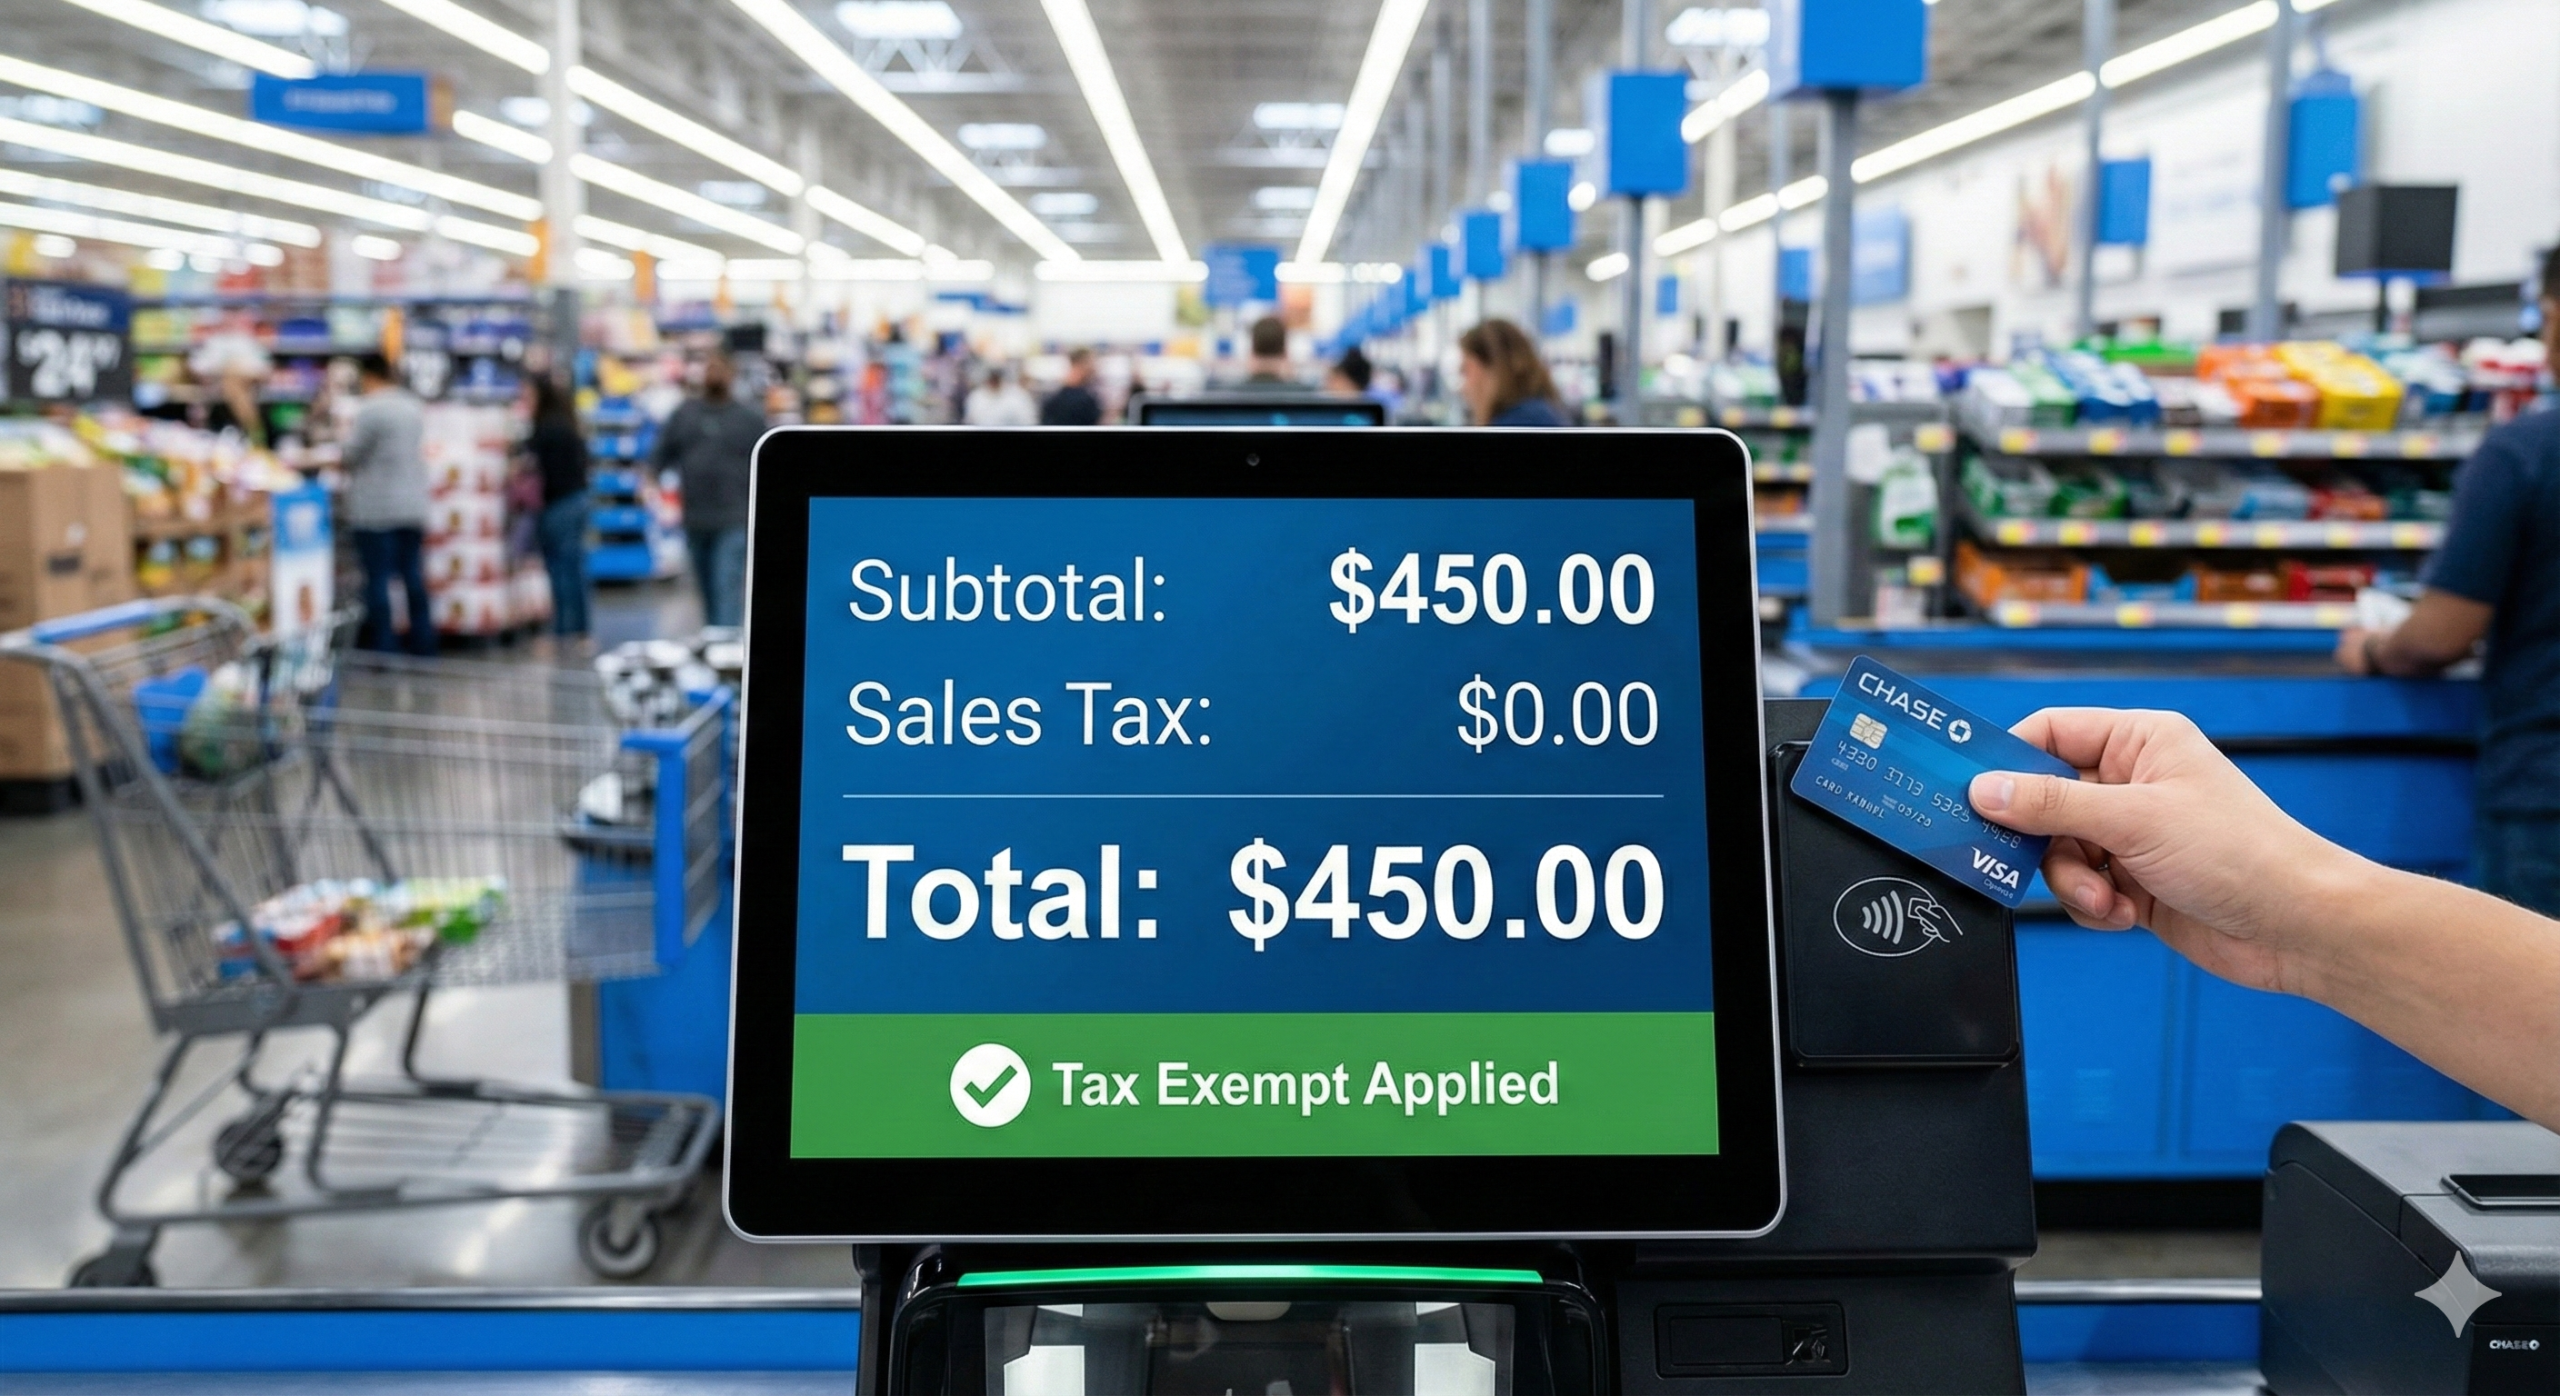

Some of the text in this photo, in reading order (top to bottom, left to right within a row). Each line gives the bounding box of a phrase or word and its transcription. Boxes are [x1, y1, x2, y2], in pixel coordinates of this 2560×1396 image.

[849, 547, 1655, 634] Subtotal: $450.00
[846, 673, 1659, 754] Sales Tax: $0.00
[1858, 672, 1948, 731] CHASE
[1837, 740, 1878, 771] 4330
[1815, 775, 1843, 795] CARD
[842, 837, 1665, 953] Total: $450.00
[1970, 846, 2020, 889] VISA
[1052, 1060, 1559, 1117] Tax Exempt Applied
